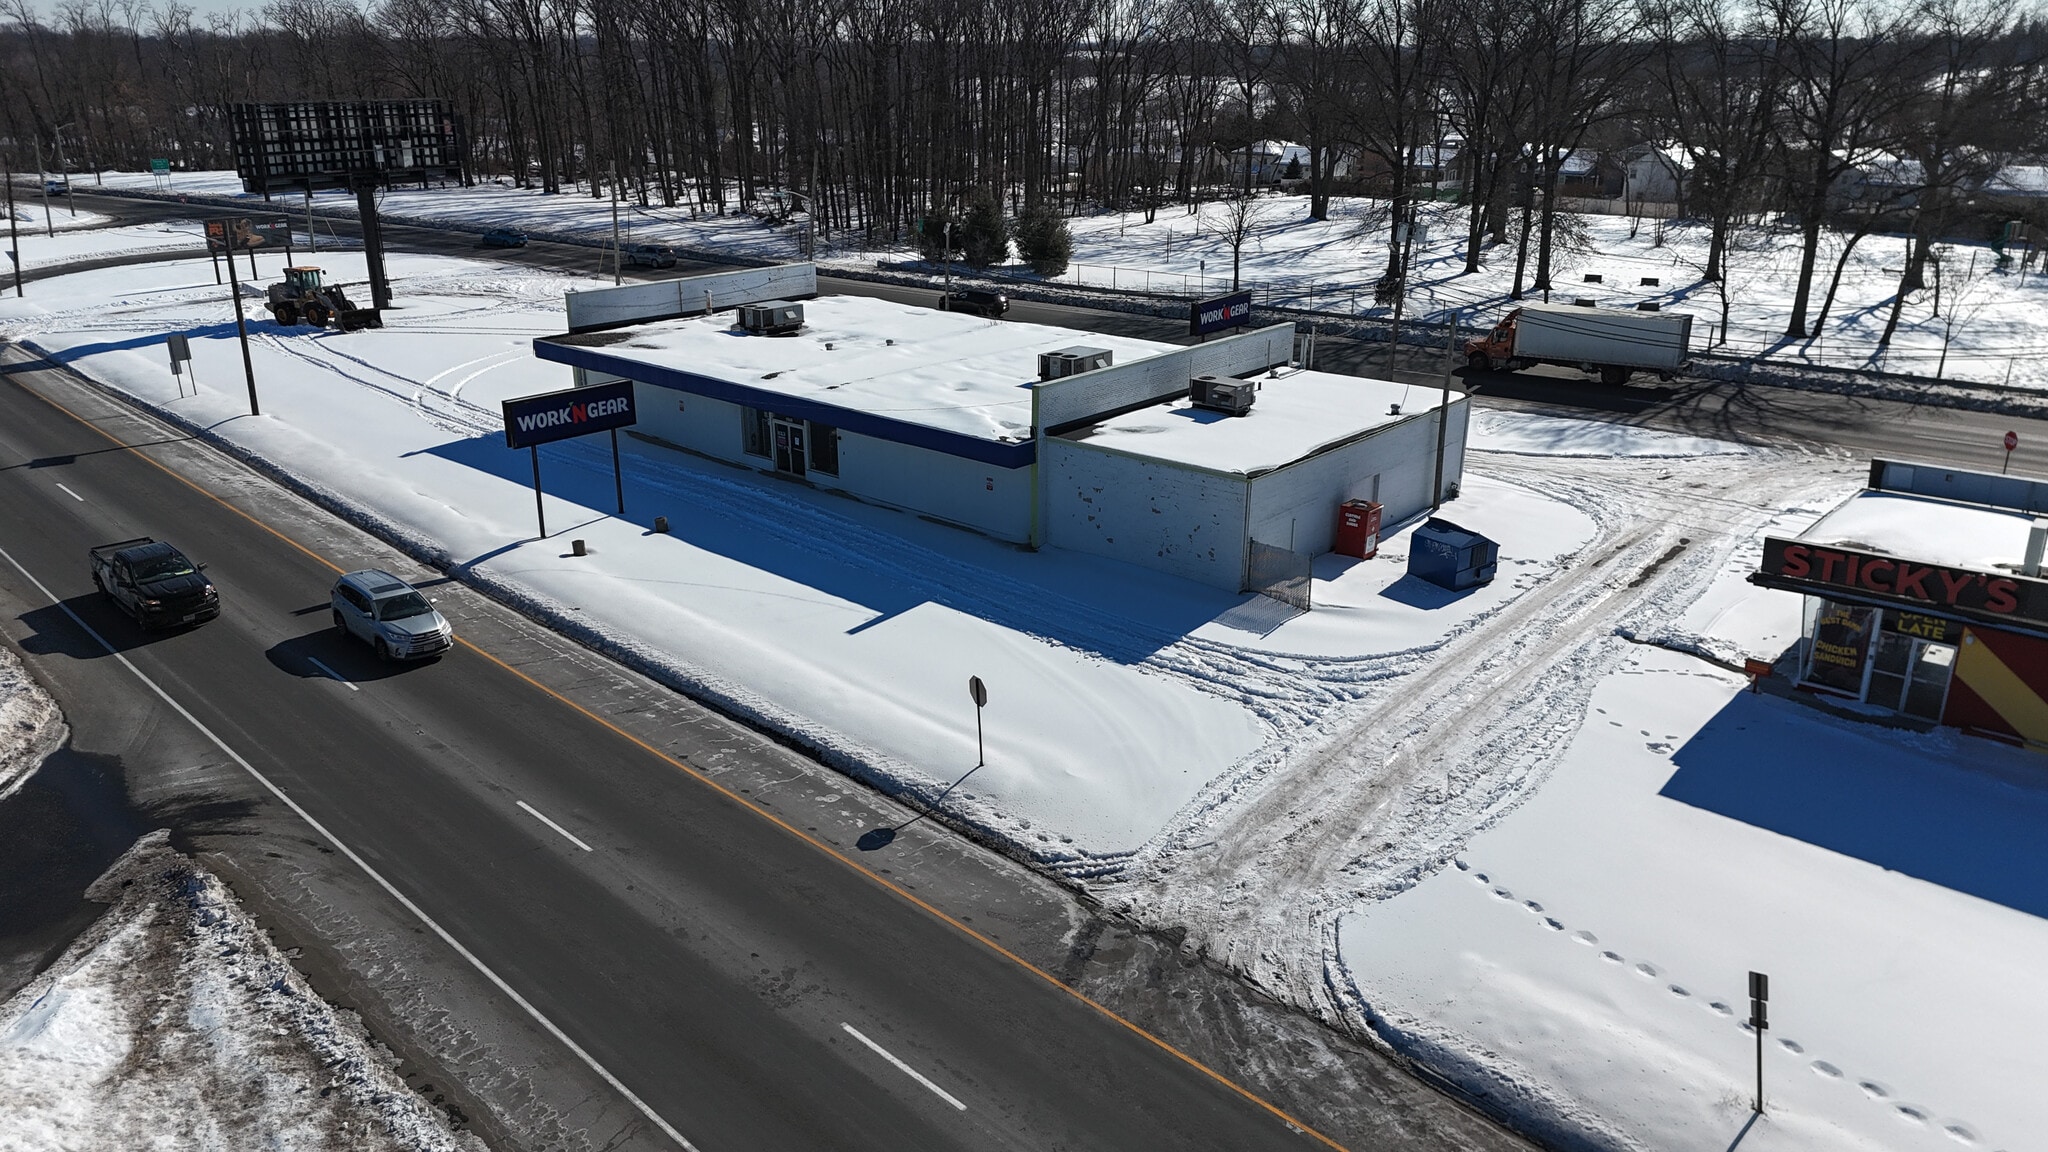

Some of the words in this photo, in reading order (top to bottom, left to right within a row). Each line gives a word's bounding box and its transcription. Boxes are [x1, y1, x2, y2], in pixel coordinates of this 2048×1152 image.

[1781, 545, 2019, 613] STICKY'S
[1897, 619, 1946, 640] LATE
[1816, 640, 1857, 656] CHICKEN
[1814, 652, 1856, 668] SANDWICH
